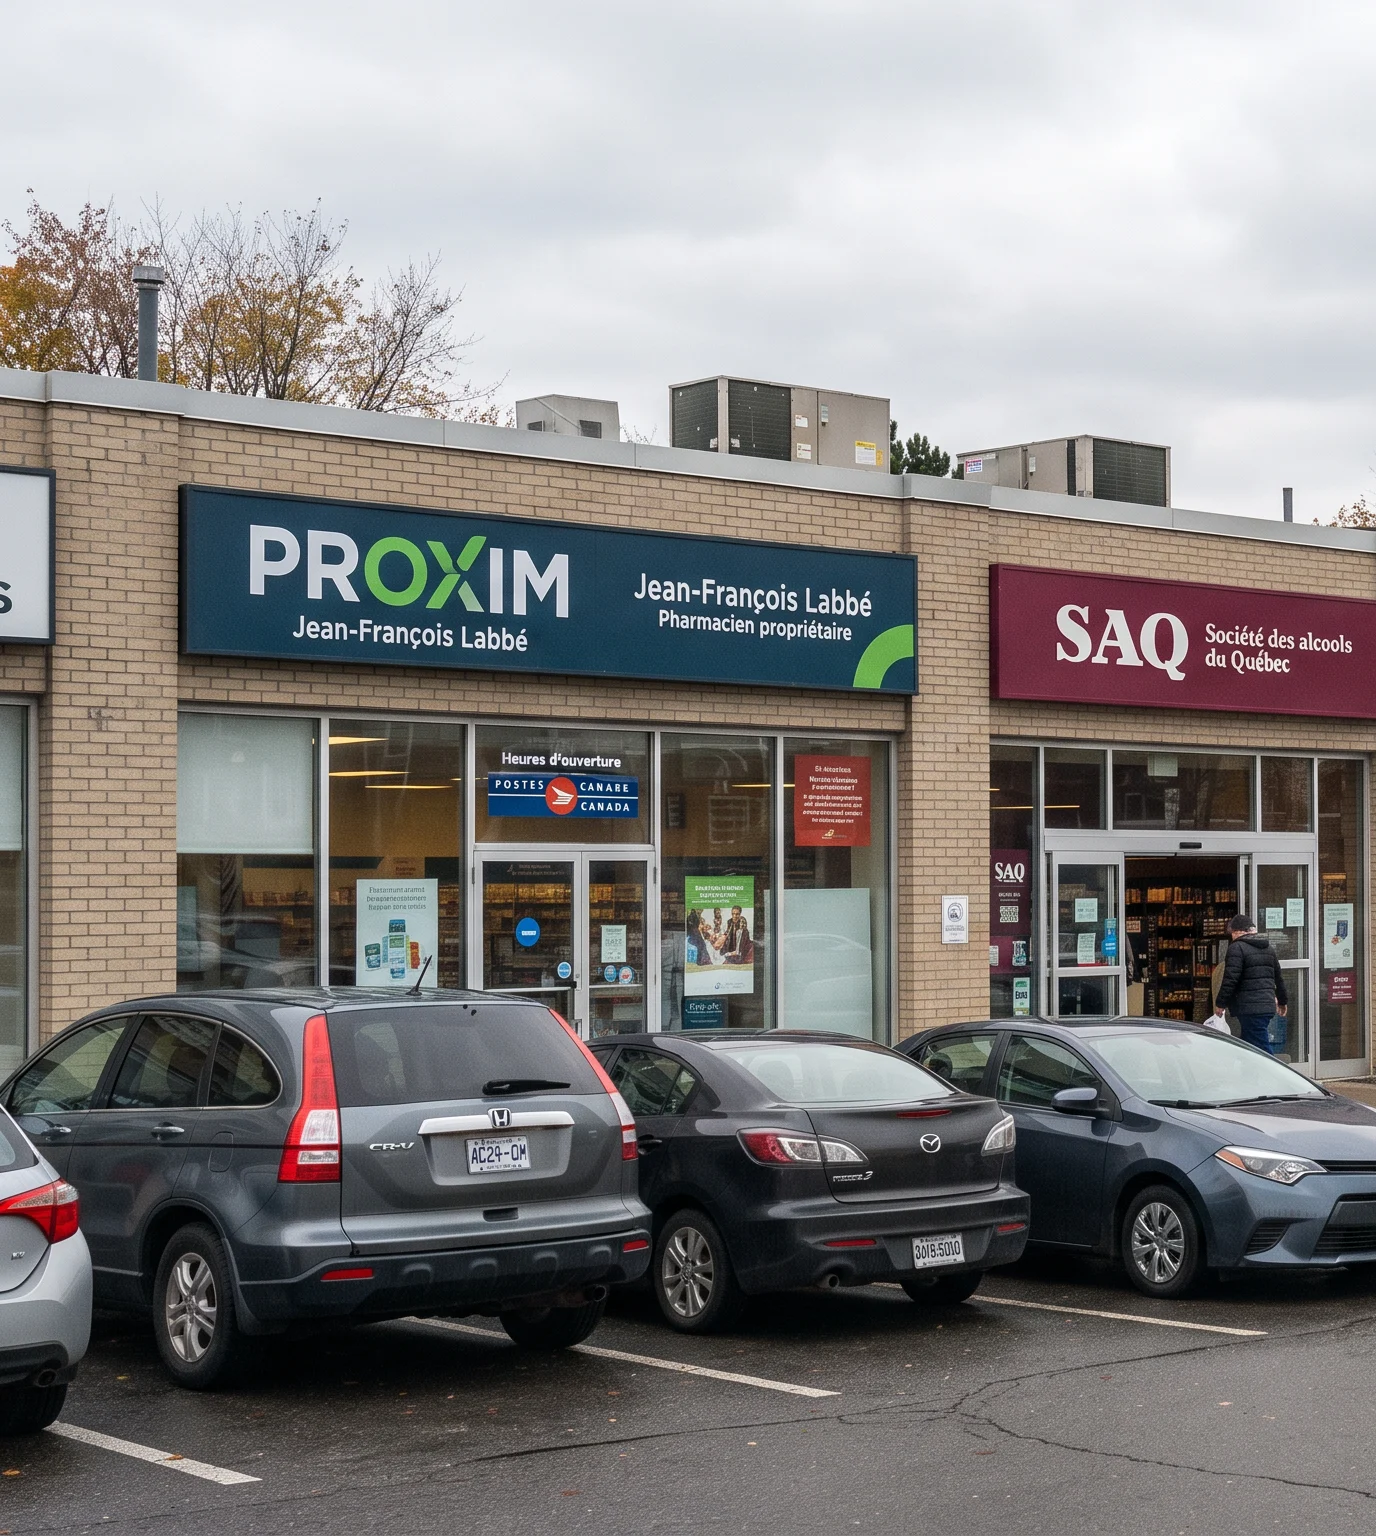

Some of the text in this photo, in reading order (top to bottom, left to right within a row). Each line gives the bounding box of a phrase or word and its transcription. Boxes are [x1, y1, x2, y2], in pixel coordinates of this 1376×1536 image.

[249, 524, 569, 618] PROXIM
[634, 572, 872, 617] Jean-François Labbé
[292, 615, 528, 653] Jean-François Labbé
[658, 609, 853, 643] Pharmacien propriétaire
[1205, 623, 1353, 654] Société des alcools
[1056, 604, 1189, 681] SAQ
[1205, 648, 1291, 675] du Québec
[502, 752, 622, 768] Heures d'ouverture
[495, 780, 544, 790] POSTES
[580, 801, 630, 812] CANADA
[994, 862, 1026, 883] SAQ
[369, 1142, 415, 1151] CR-V
